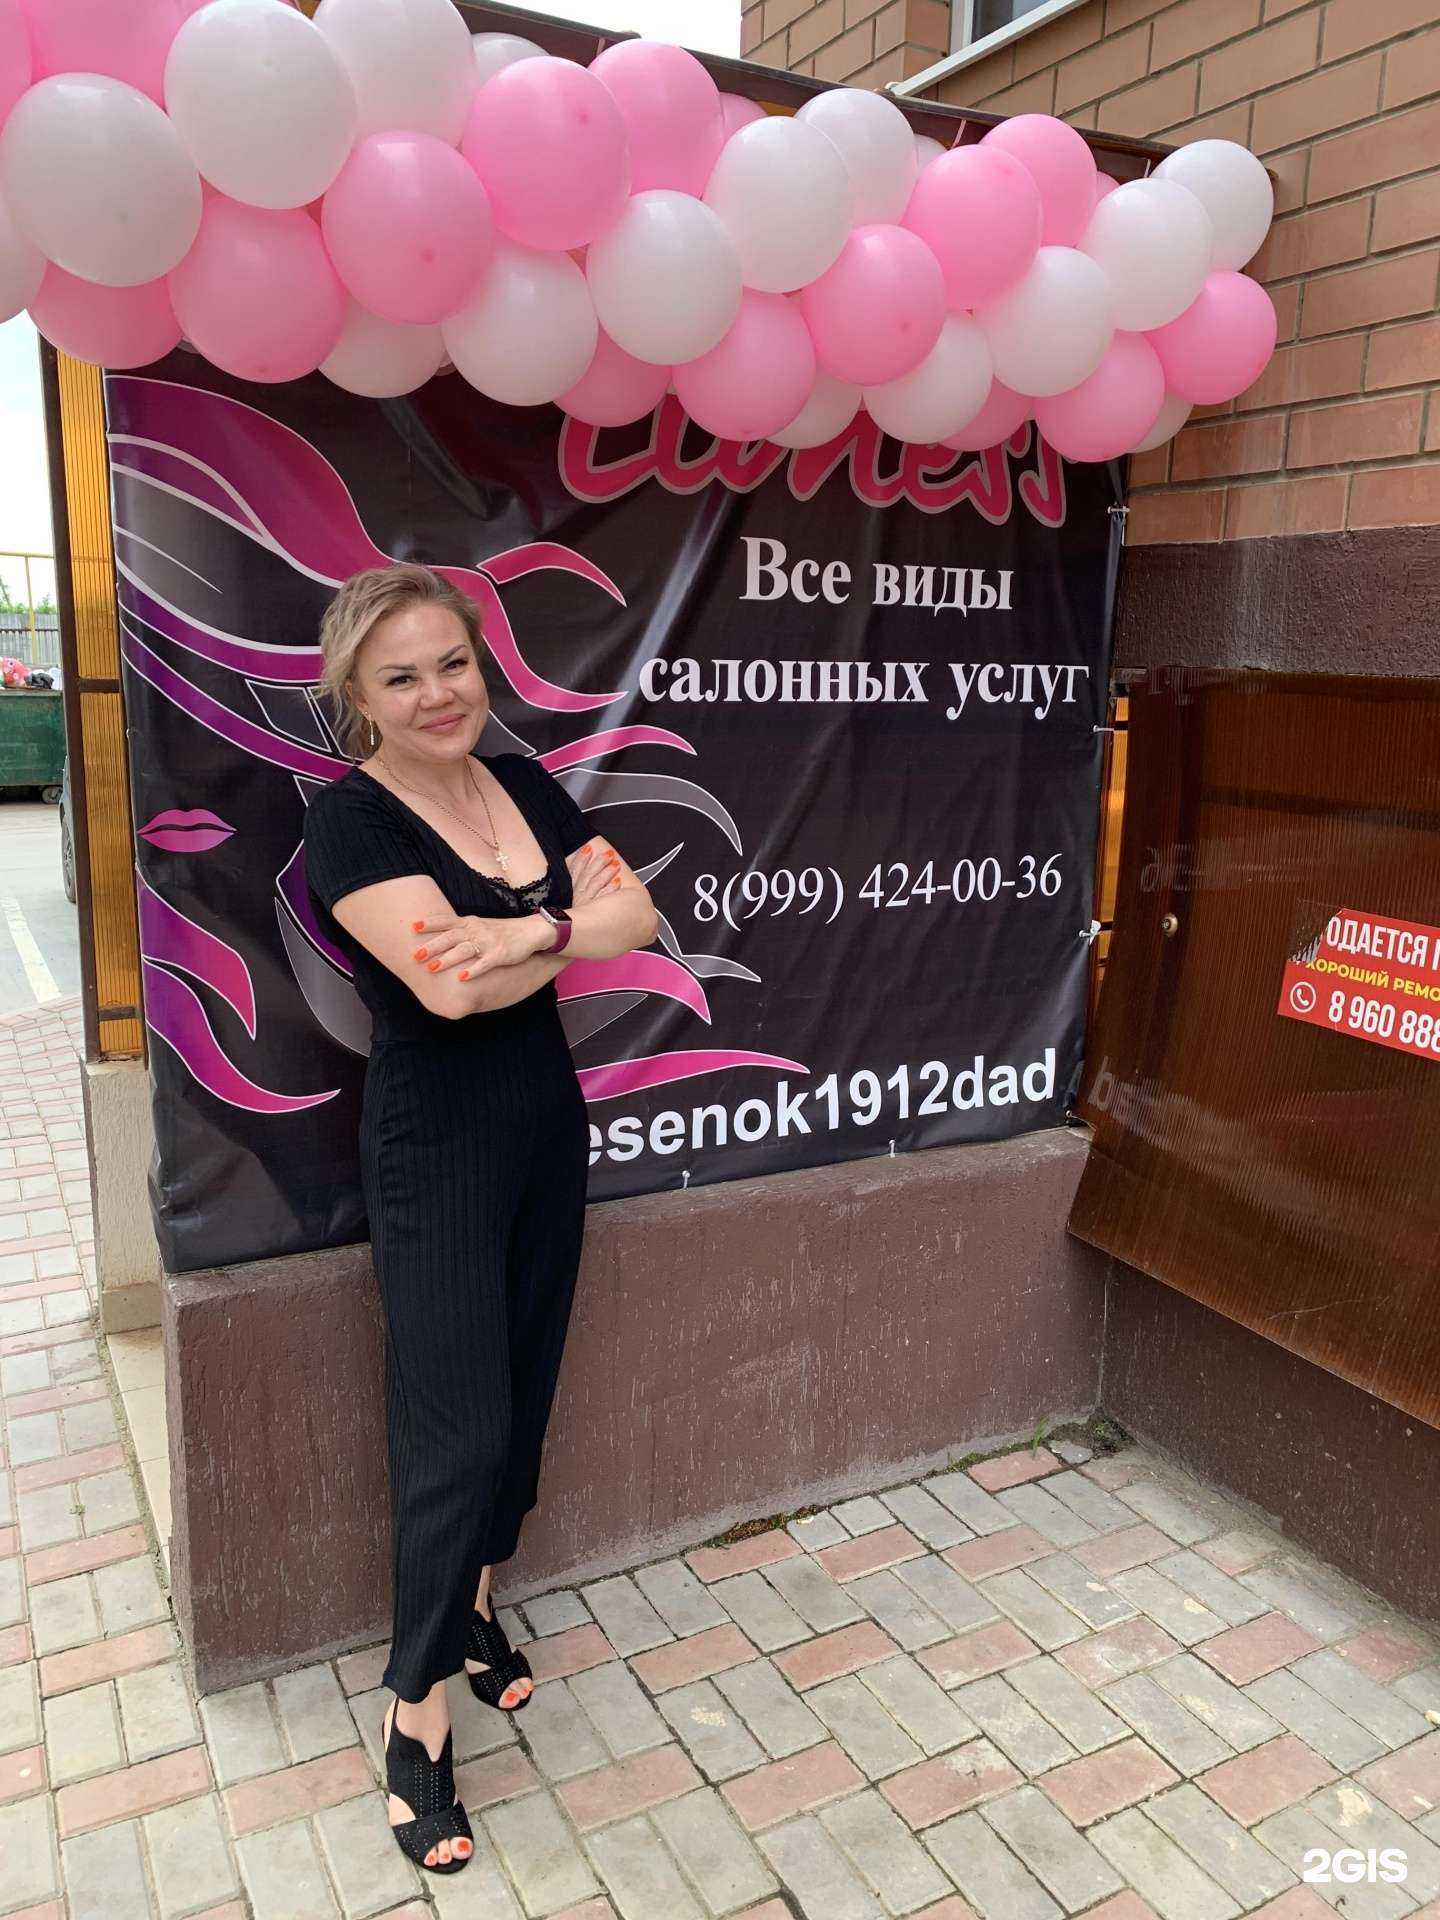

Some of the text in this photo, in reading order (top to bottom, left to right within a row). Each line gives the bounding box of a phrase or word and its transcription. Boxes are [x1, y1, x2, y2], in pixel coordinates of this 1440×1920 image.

[739, 536, 1014, 617] Все виды
[638, 655, 929, 702] салонных
[947, 662, 1089, 720] услуг
[693, 853, 1063, 932] 8(999) 424-00-36
[1328, 990, 1346, 1023] 8
[1348, 995, 1396, 1037] 960
